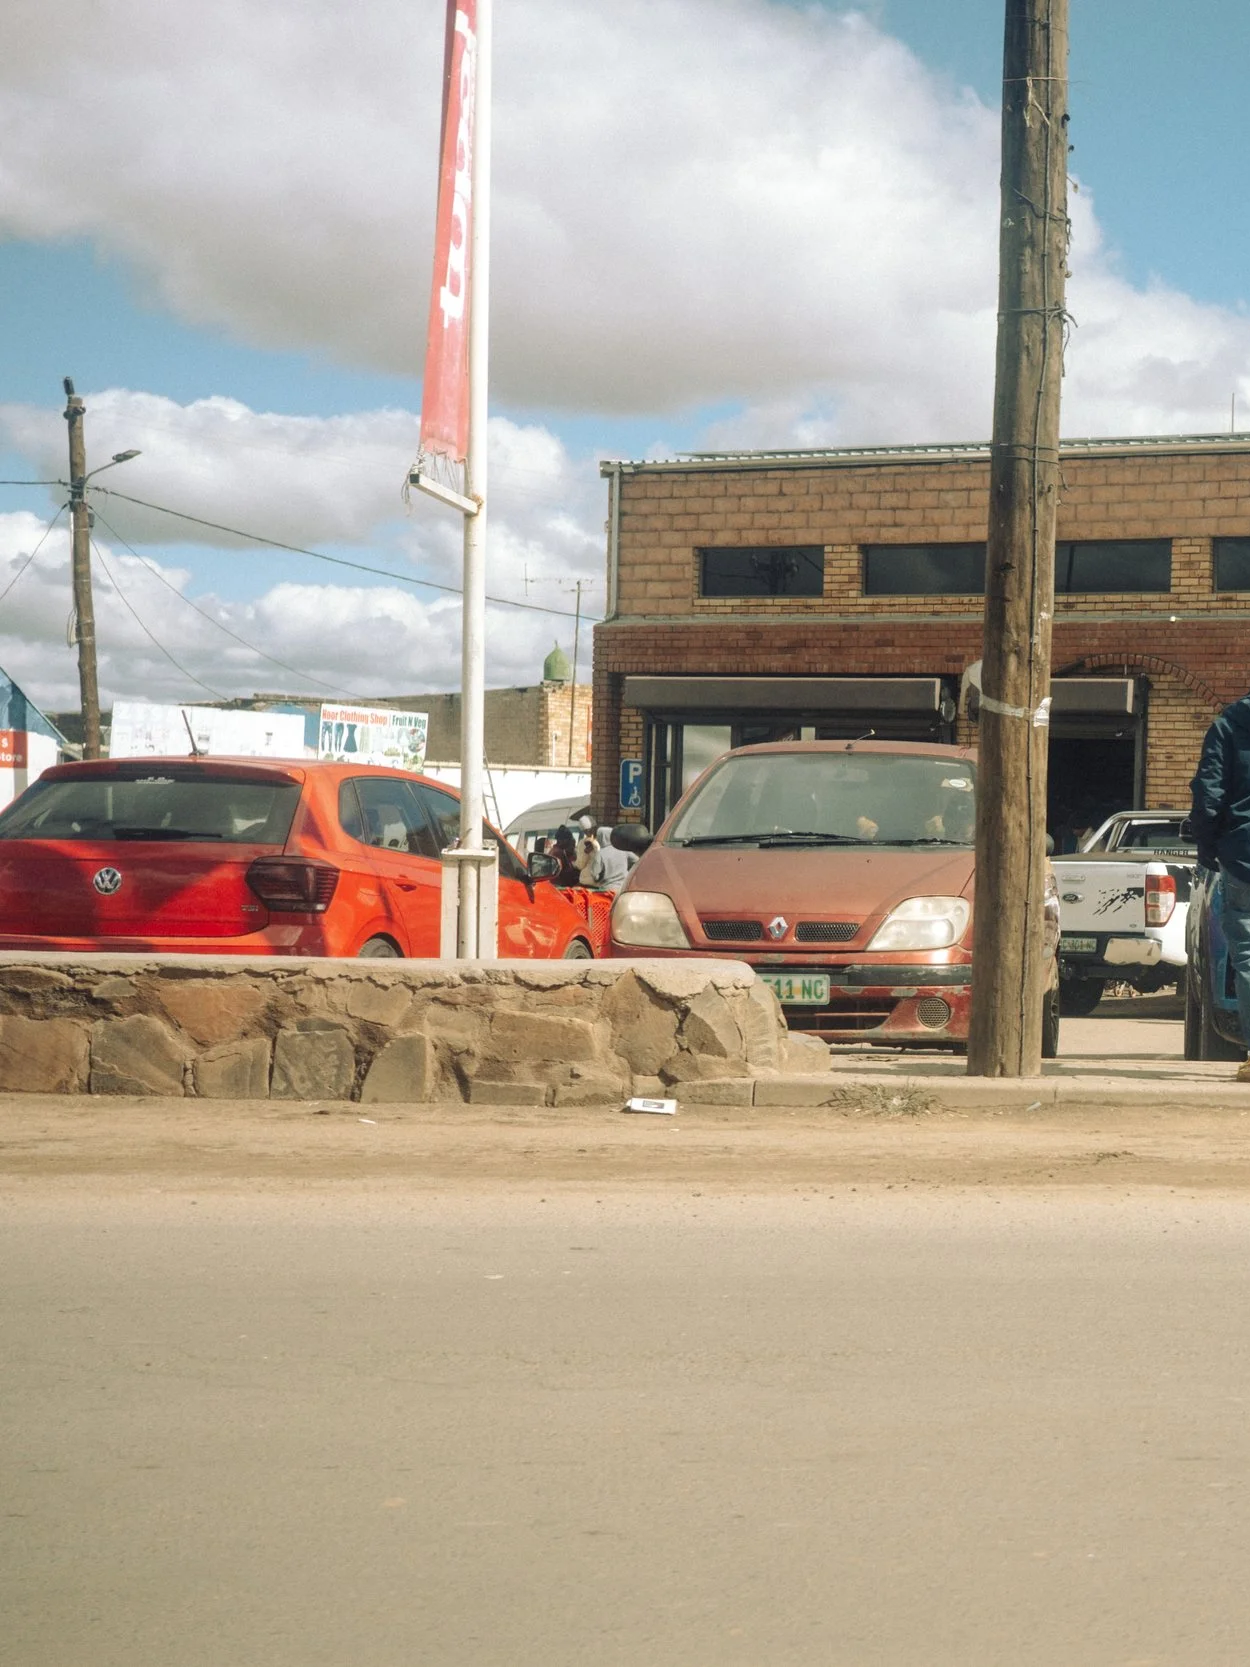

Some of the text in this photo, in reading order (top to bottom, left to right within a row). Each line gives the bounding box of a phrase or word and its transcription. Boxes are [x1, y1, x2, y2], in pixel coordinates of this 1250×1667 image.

[340, 710, 369, 724] Clothing
[370, 712, 388, 727] Shop
[392, 714, 407, 727] Fruit
[414, 716, 427, 730] Veg
[629, 763, 642, 784] P
[763, 978, 824, 999] 11 NC
